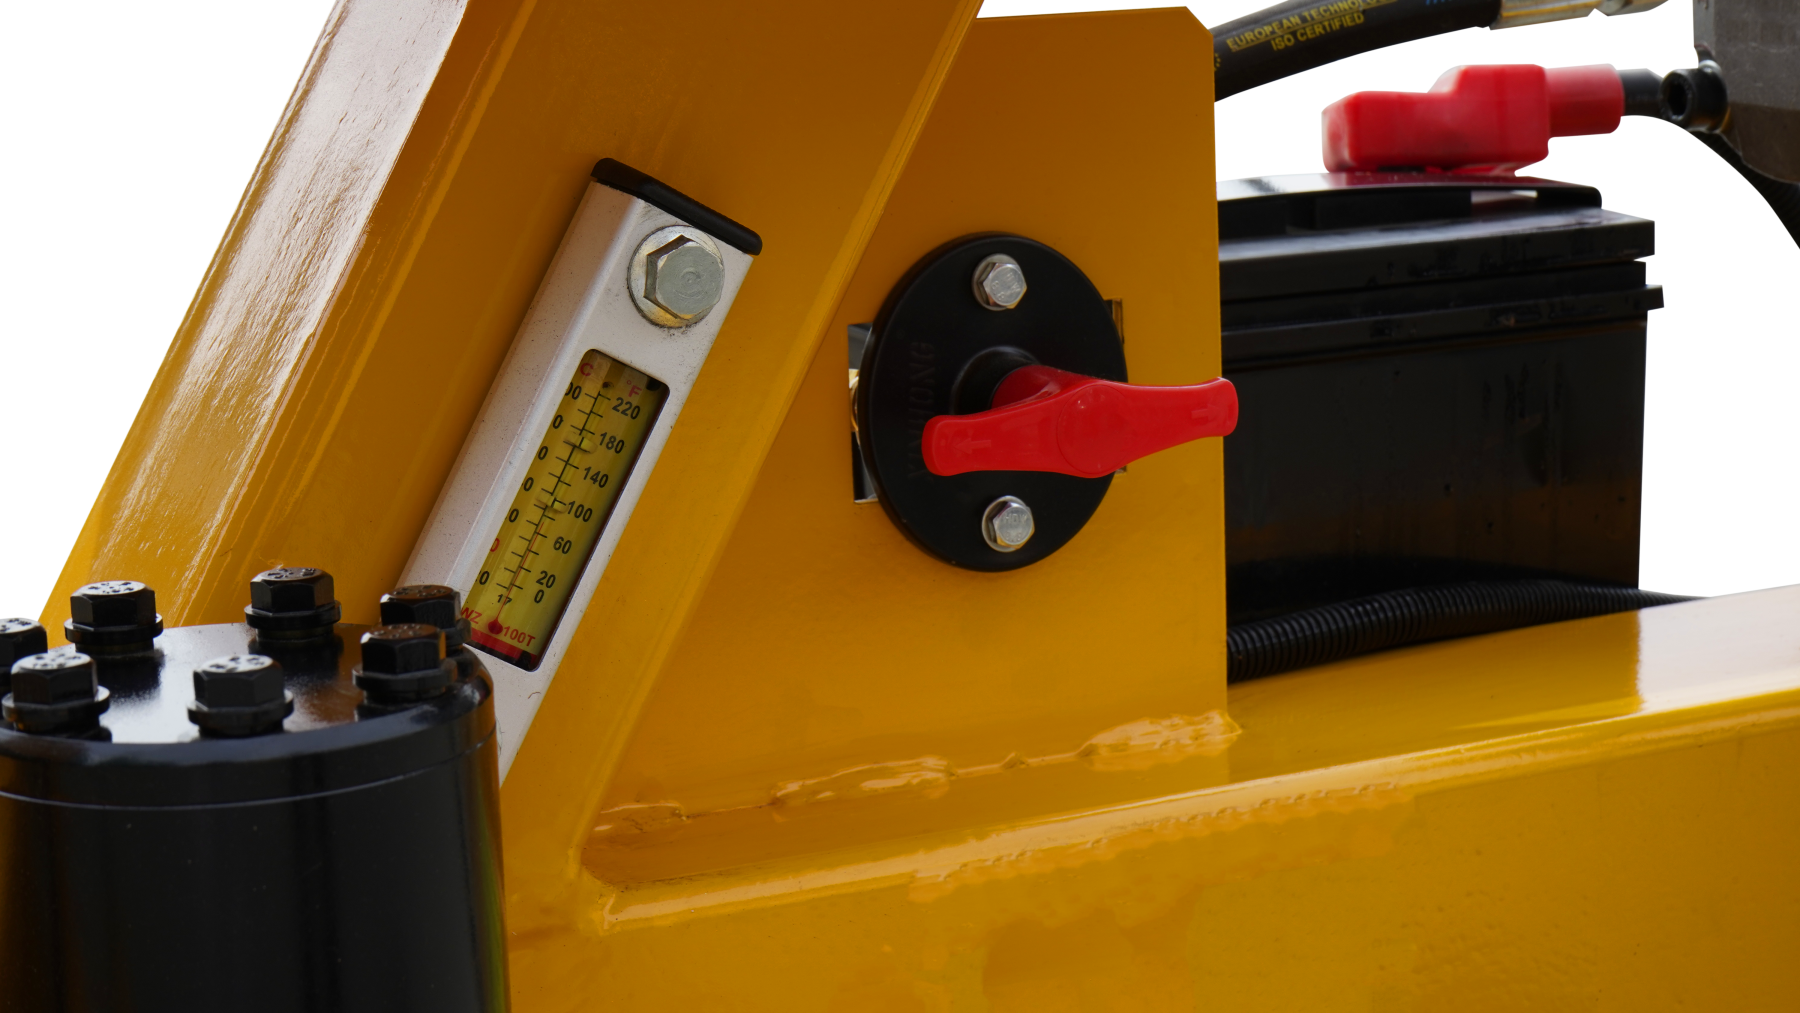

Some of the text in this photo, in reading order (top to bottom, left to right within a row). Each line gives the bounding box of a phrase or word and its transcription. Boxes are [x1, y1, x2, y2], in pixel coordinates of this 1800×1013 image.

[1226, 14, 1302, 51] EUROPEAN
[1271, 12, 1365, 51] ISO CERTIFIED
[612, 397, 641, 420] 220
[599, 431, 625, 454] 180
[583, 466, 609, 488] 140
[567, 501, 593, 522] 100
[553, 536, 572, 555] 60
[536, 570, 556, 589] 20
[533, 589, 545, 604] 0
[503, 626, 536, 647] 100T
